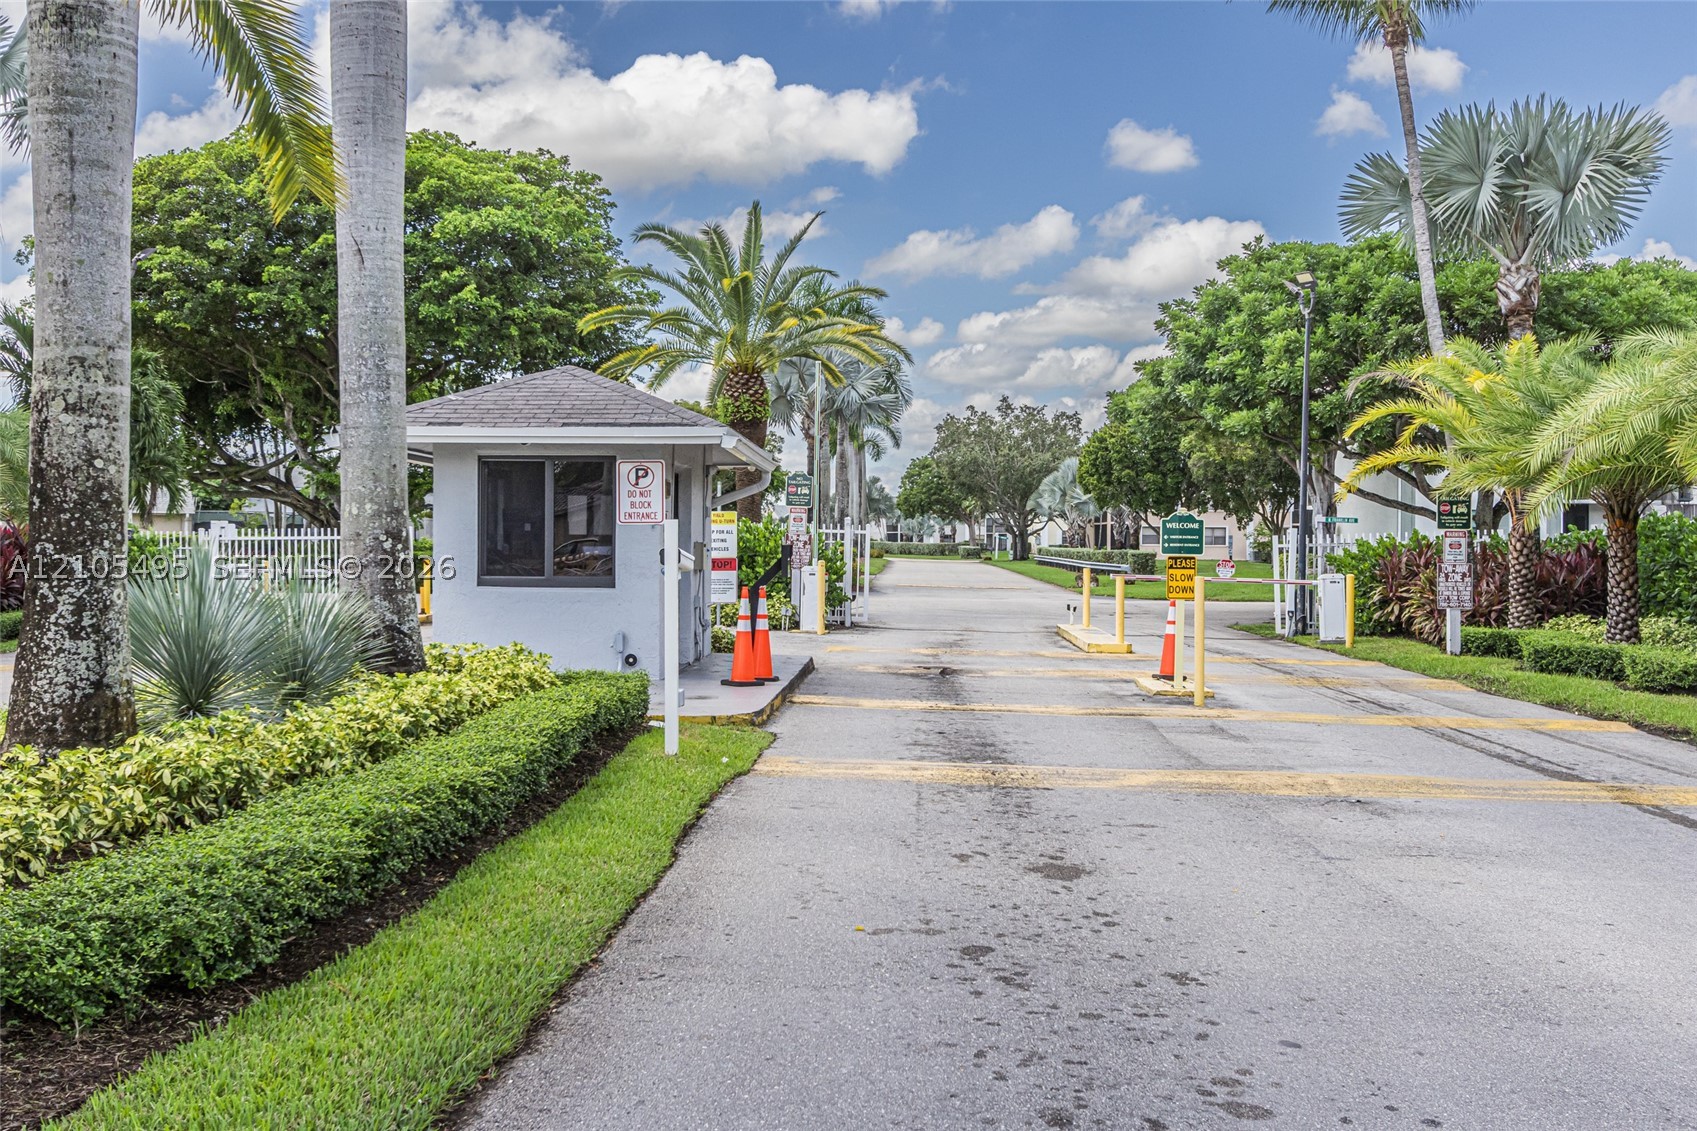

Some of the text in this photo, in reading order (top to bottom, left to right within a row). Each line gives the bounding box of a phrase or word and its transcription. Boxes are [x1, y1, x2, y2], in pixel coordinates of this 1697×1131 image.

[628, 490, 652, 498] DO NOT
[630, 501, 652, 509] BLOCK
[624, 512, 658, 520] ENTRANCE
[1168, 559, 1195, 568] PLEASE
[1441, 564, 1470, 573] TOW-AWAY
[1170, 574, 1193, 582] SLOW
[1448, 573, 1462, 581] ZONE
[1169, 586, 1194, 594] DOWN
